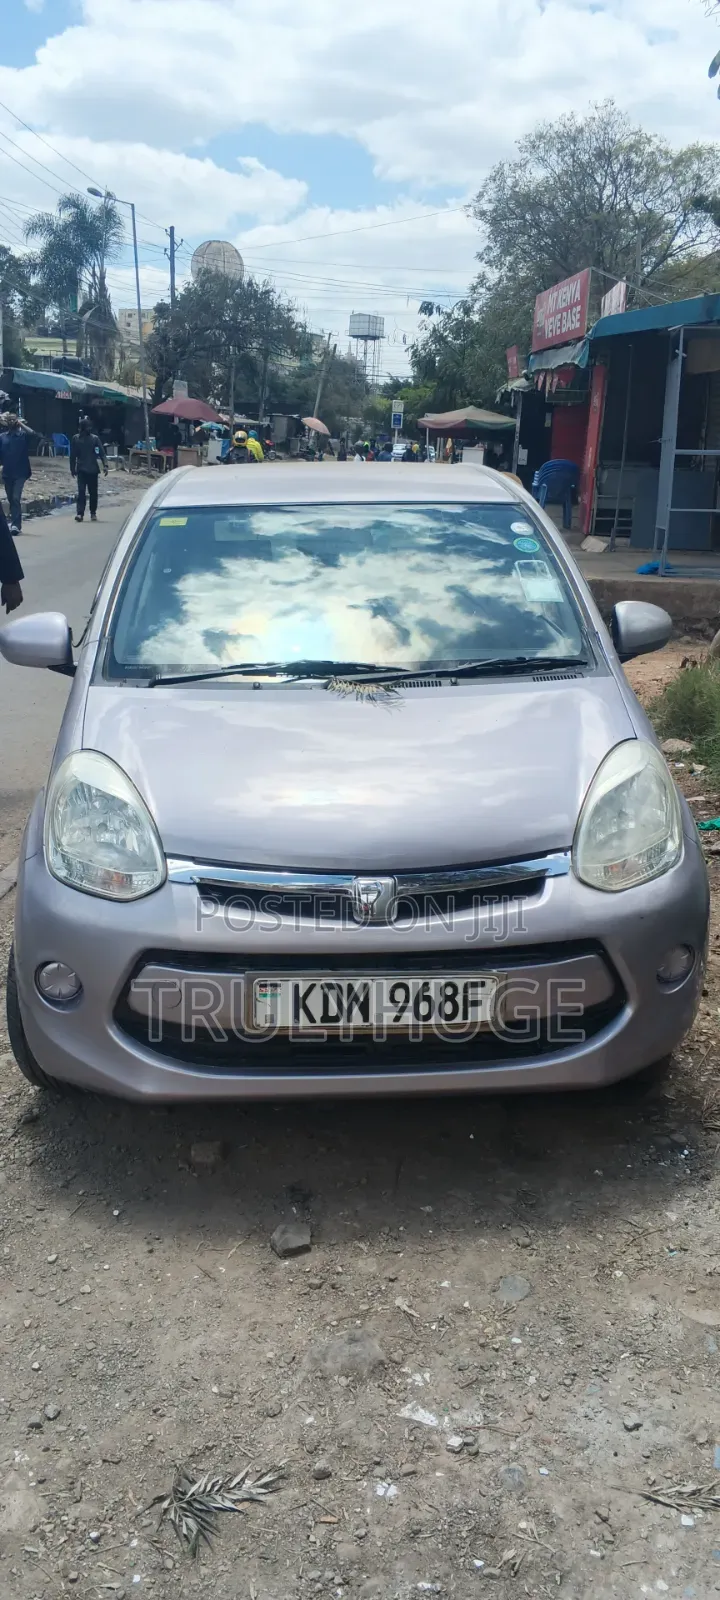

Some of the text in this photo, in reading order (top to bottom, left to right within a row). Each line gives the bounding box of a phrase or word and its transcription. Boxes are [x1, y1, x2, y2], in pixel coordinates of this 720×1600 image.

[556, 279, 581, 311] KENYA
[561, 305, 582, 333] BASE
[388, 980, 486, 1023] 968F
